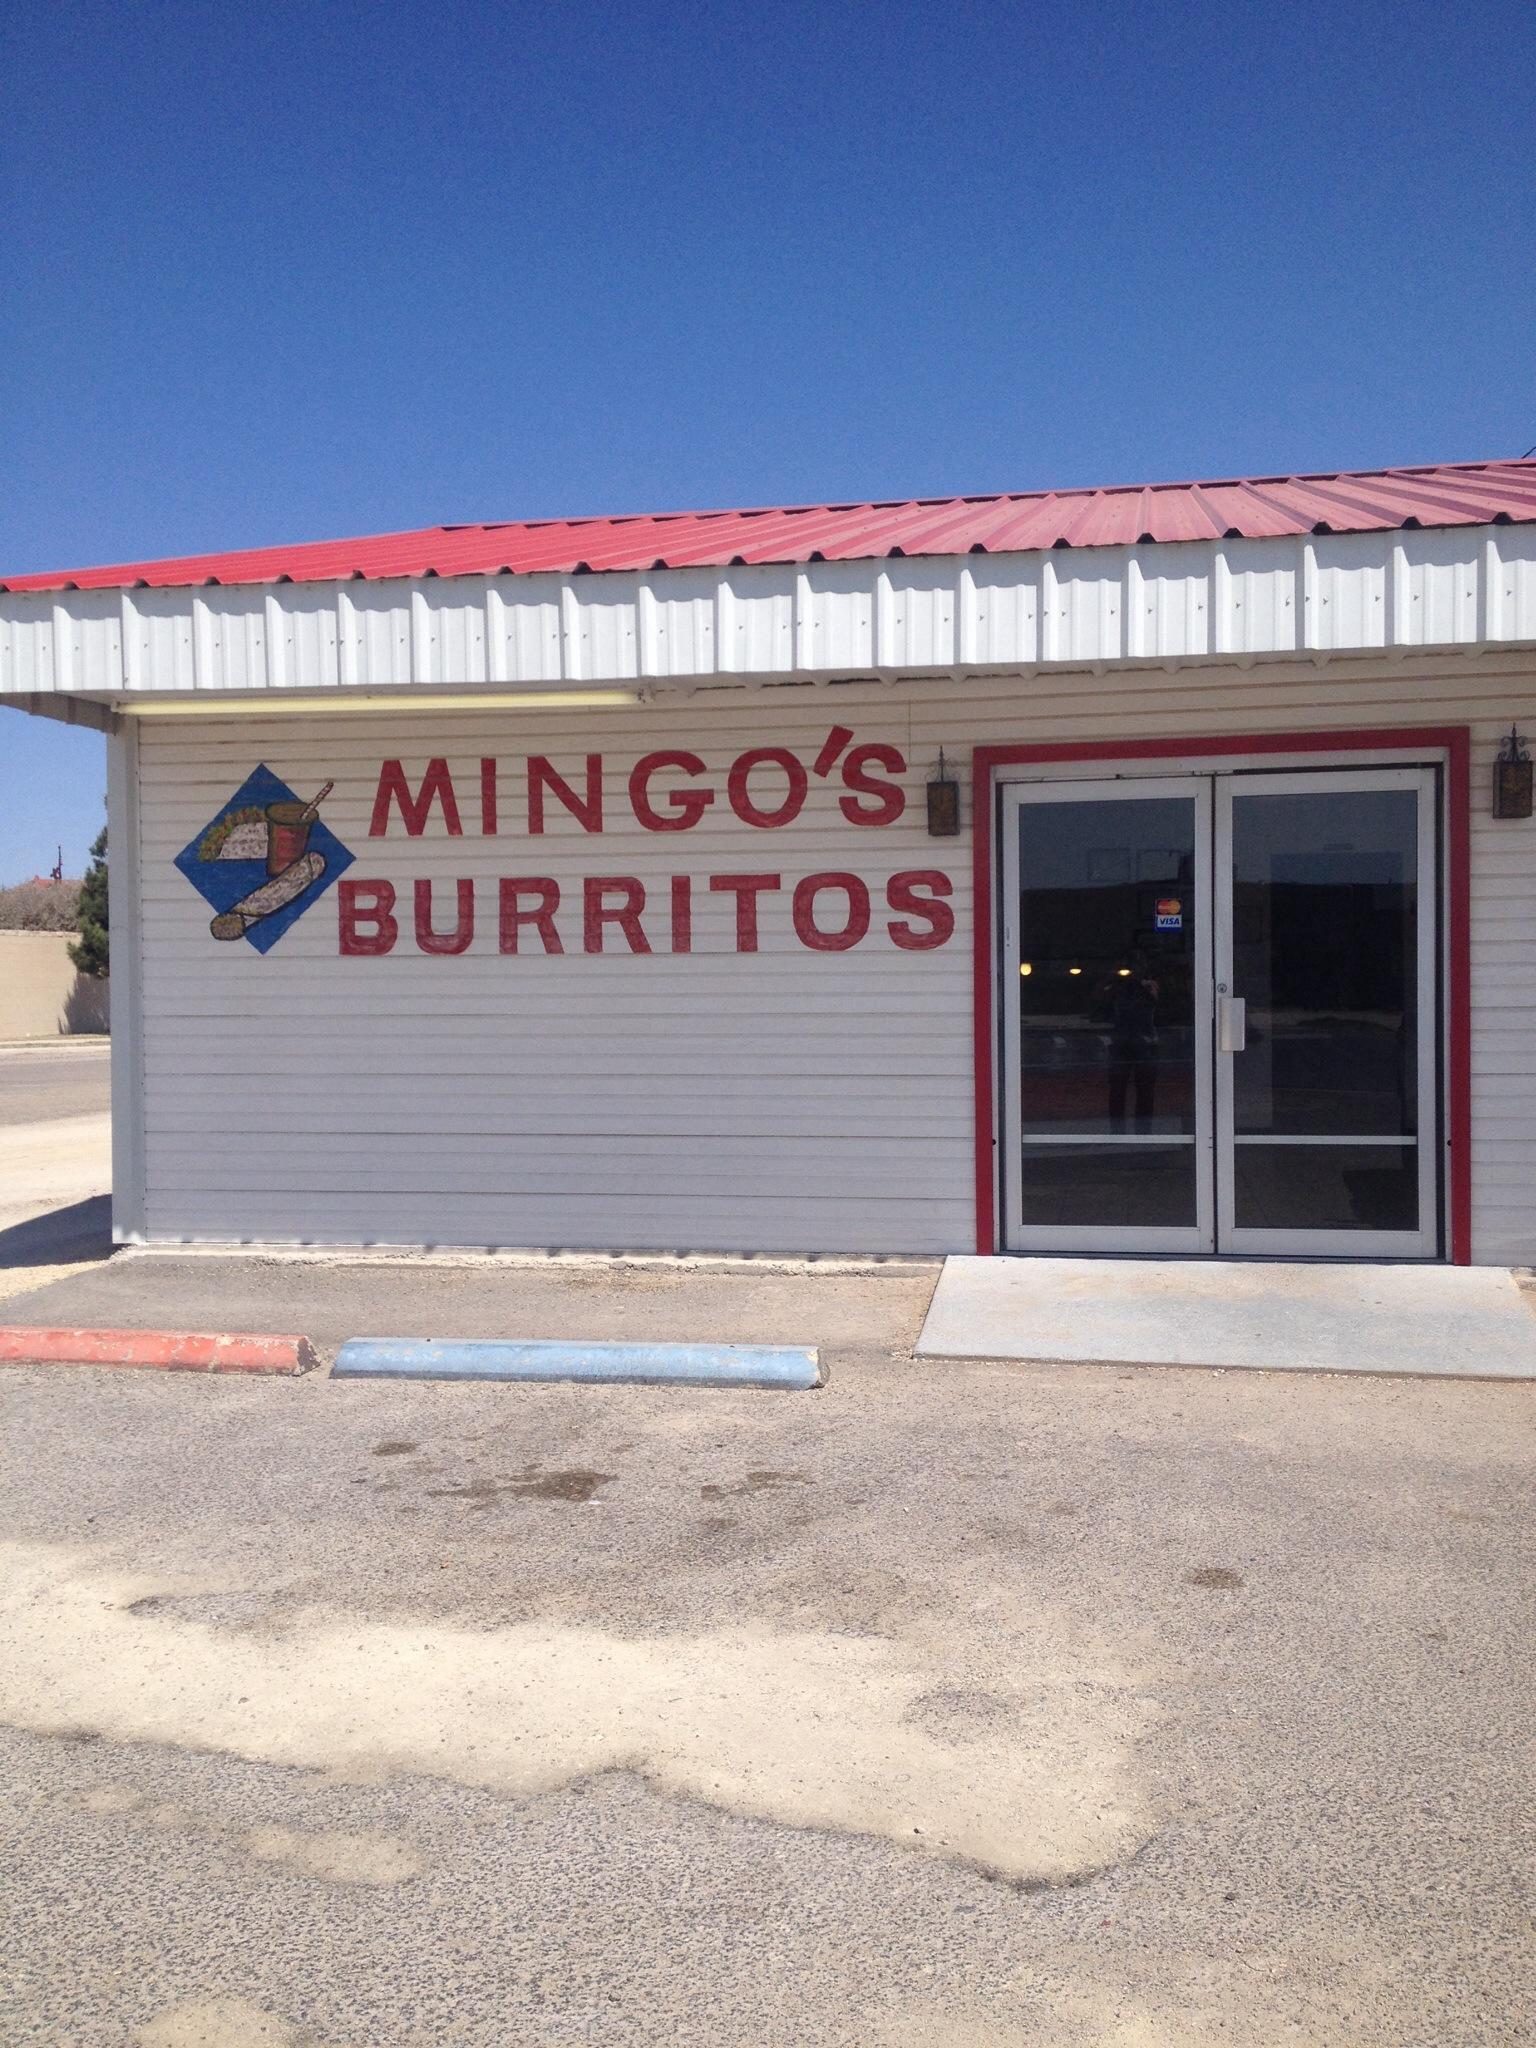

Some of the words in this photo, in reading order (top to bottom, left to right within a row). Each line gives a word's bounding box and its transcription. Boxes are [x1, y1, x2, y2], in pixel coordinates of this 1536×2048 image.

[369, 726, 906, 837] MINGO'S
[338, 870, 954, 956] BURRITOS
[1159, 917, 1180, 925] VISA
